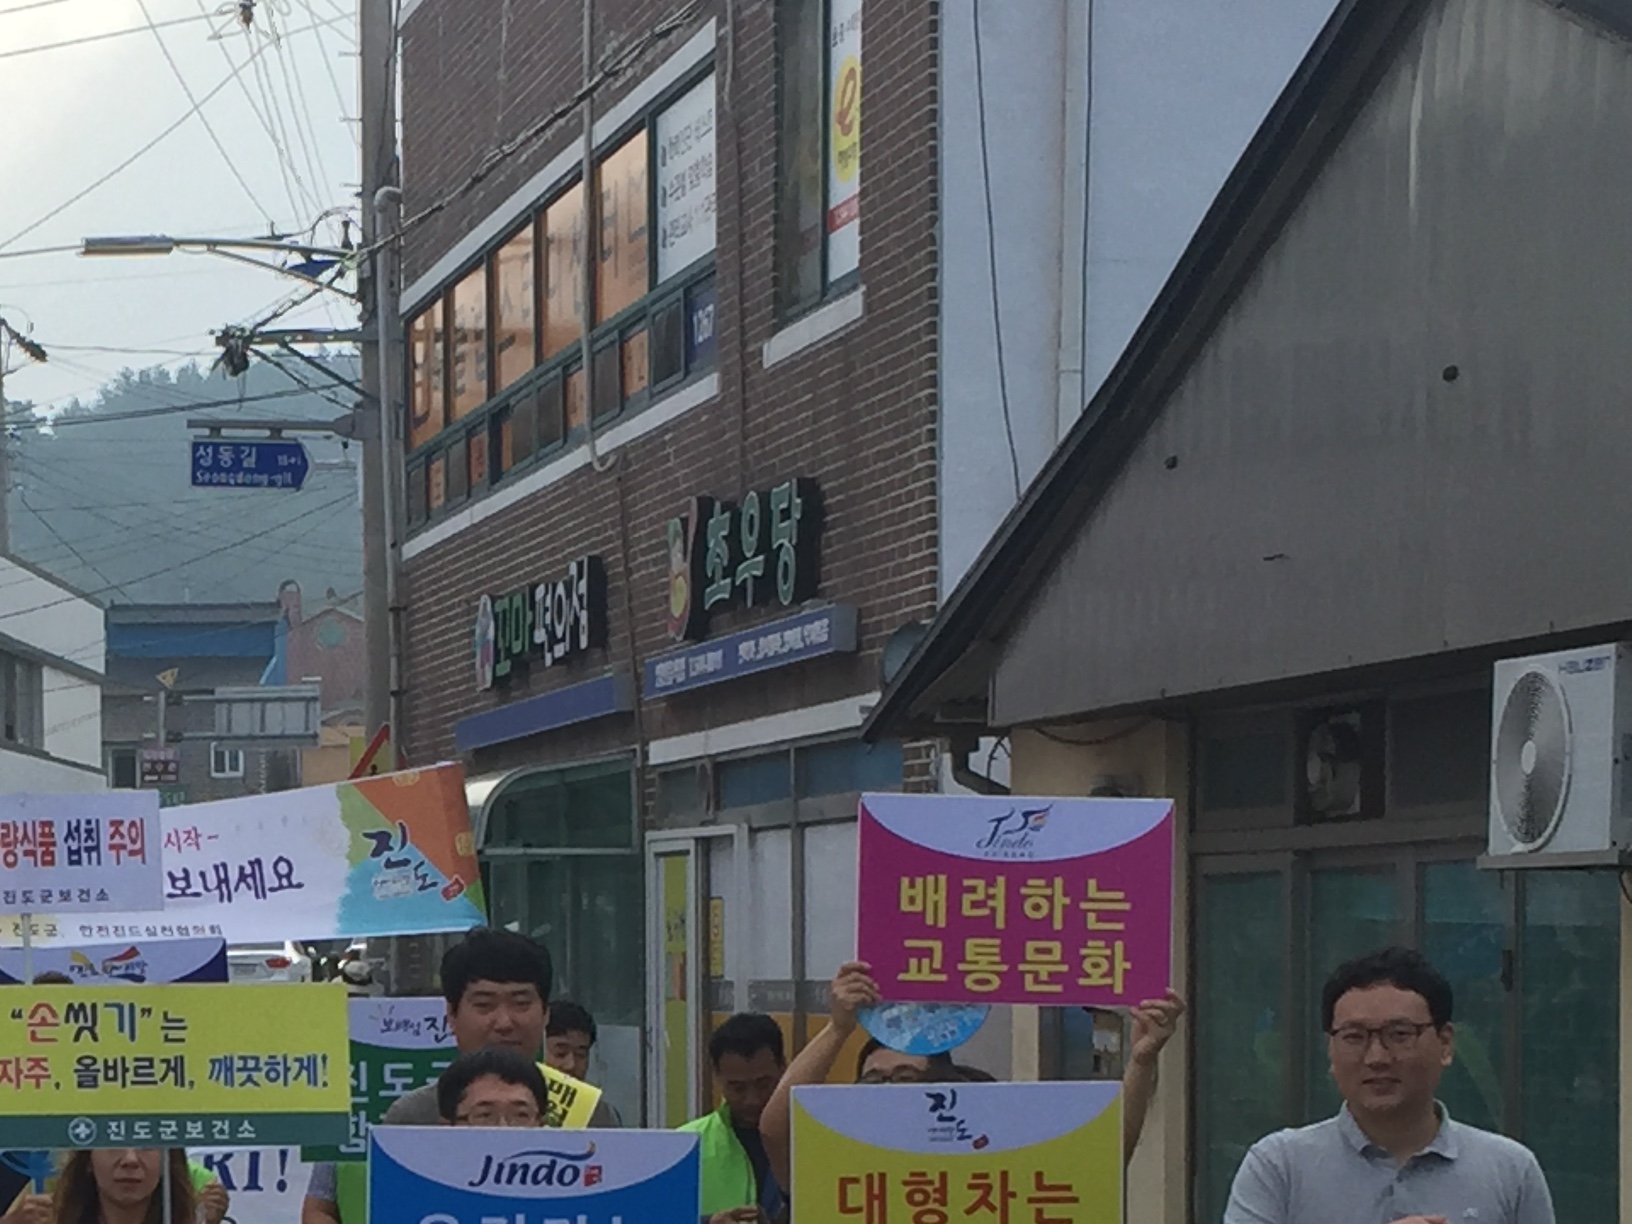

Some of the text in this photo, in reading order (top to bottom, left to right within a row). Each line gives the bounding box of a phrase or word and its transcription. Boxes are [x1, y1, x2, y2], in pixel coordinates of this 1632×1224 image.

[196, 445, 257, 468] 성동길
[704, 477, 802, 611] 초우당
[63, 818, 102, 868] 섭취
[107, 816, 146, 866] 주의
[165, 854, 305, 903] 보내세요
[897, 873, 1132, 931] 배려하는
[896, 938, 1132, 994] 교통문화
[73, 1055, 195, 1091] 올바르게,
[207, 1053, 329, 1089] 깨끗하게!
[105, 1119, 258, 1141] 진도군보건소
[468, 1153, 581, 1188] Jindo
